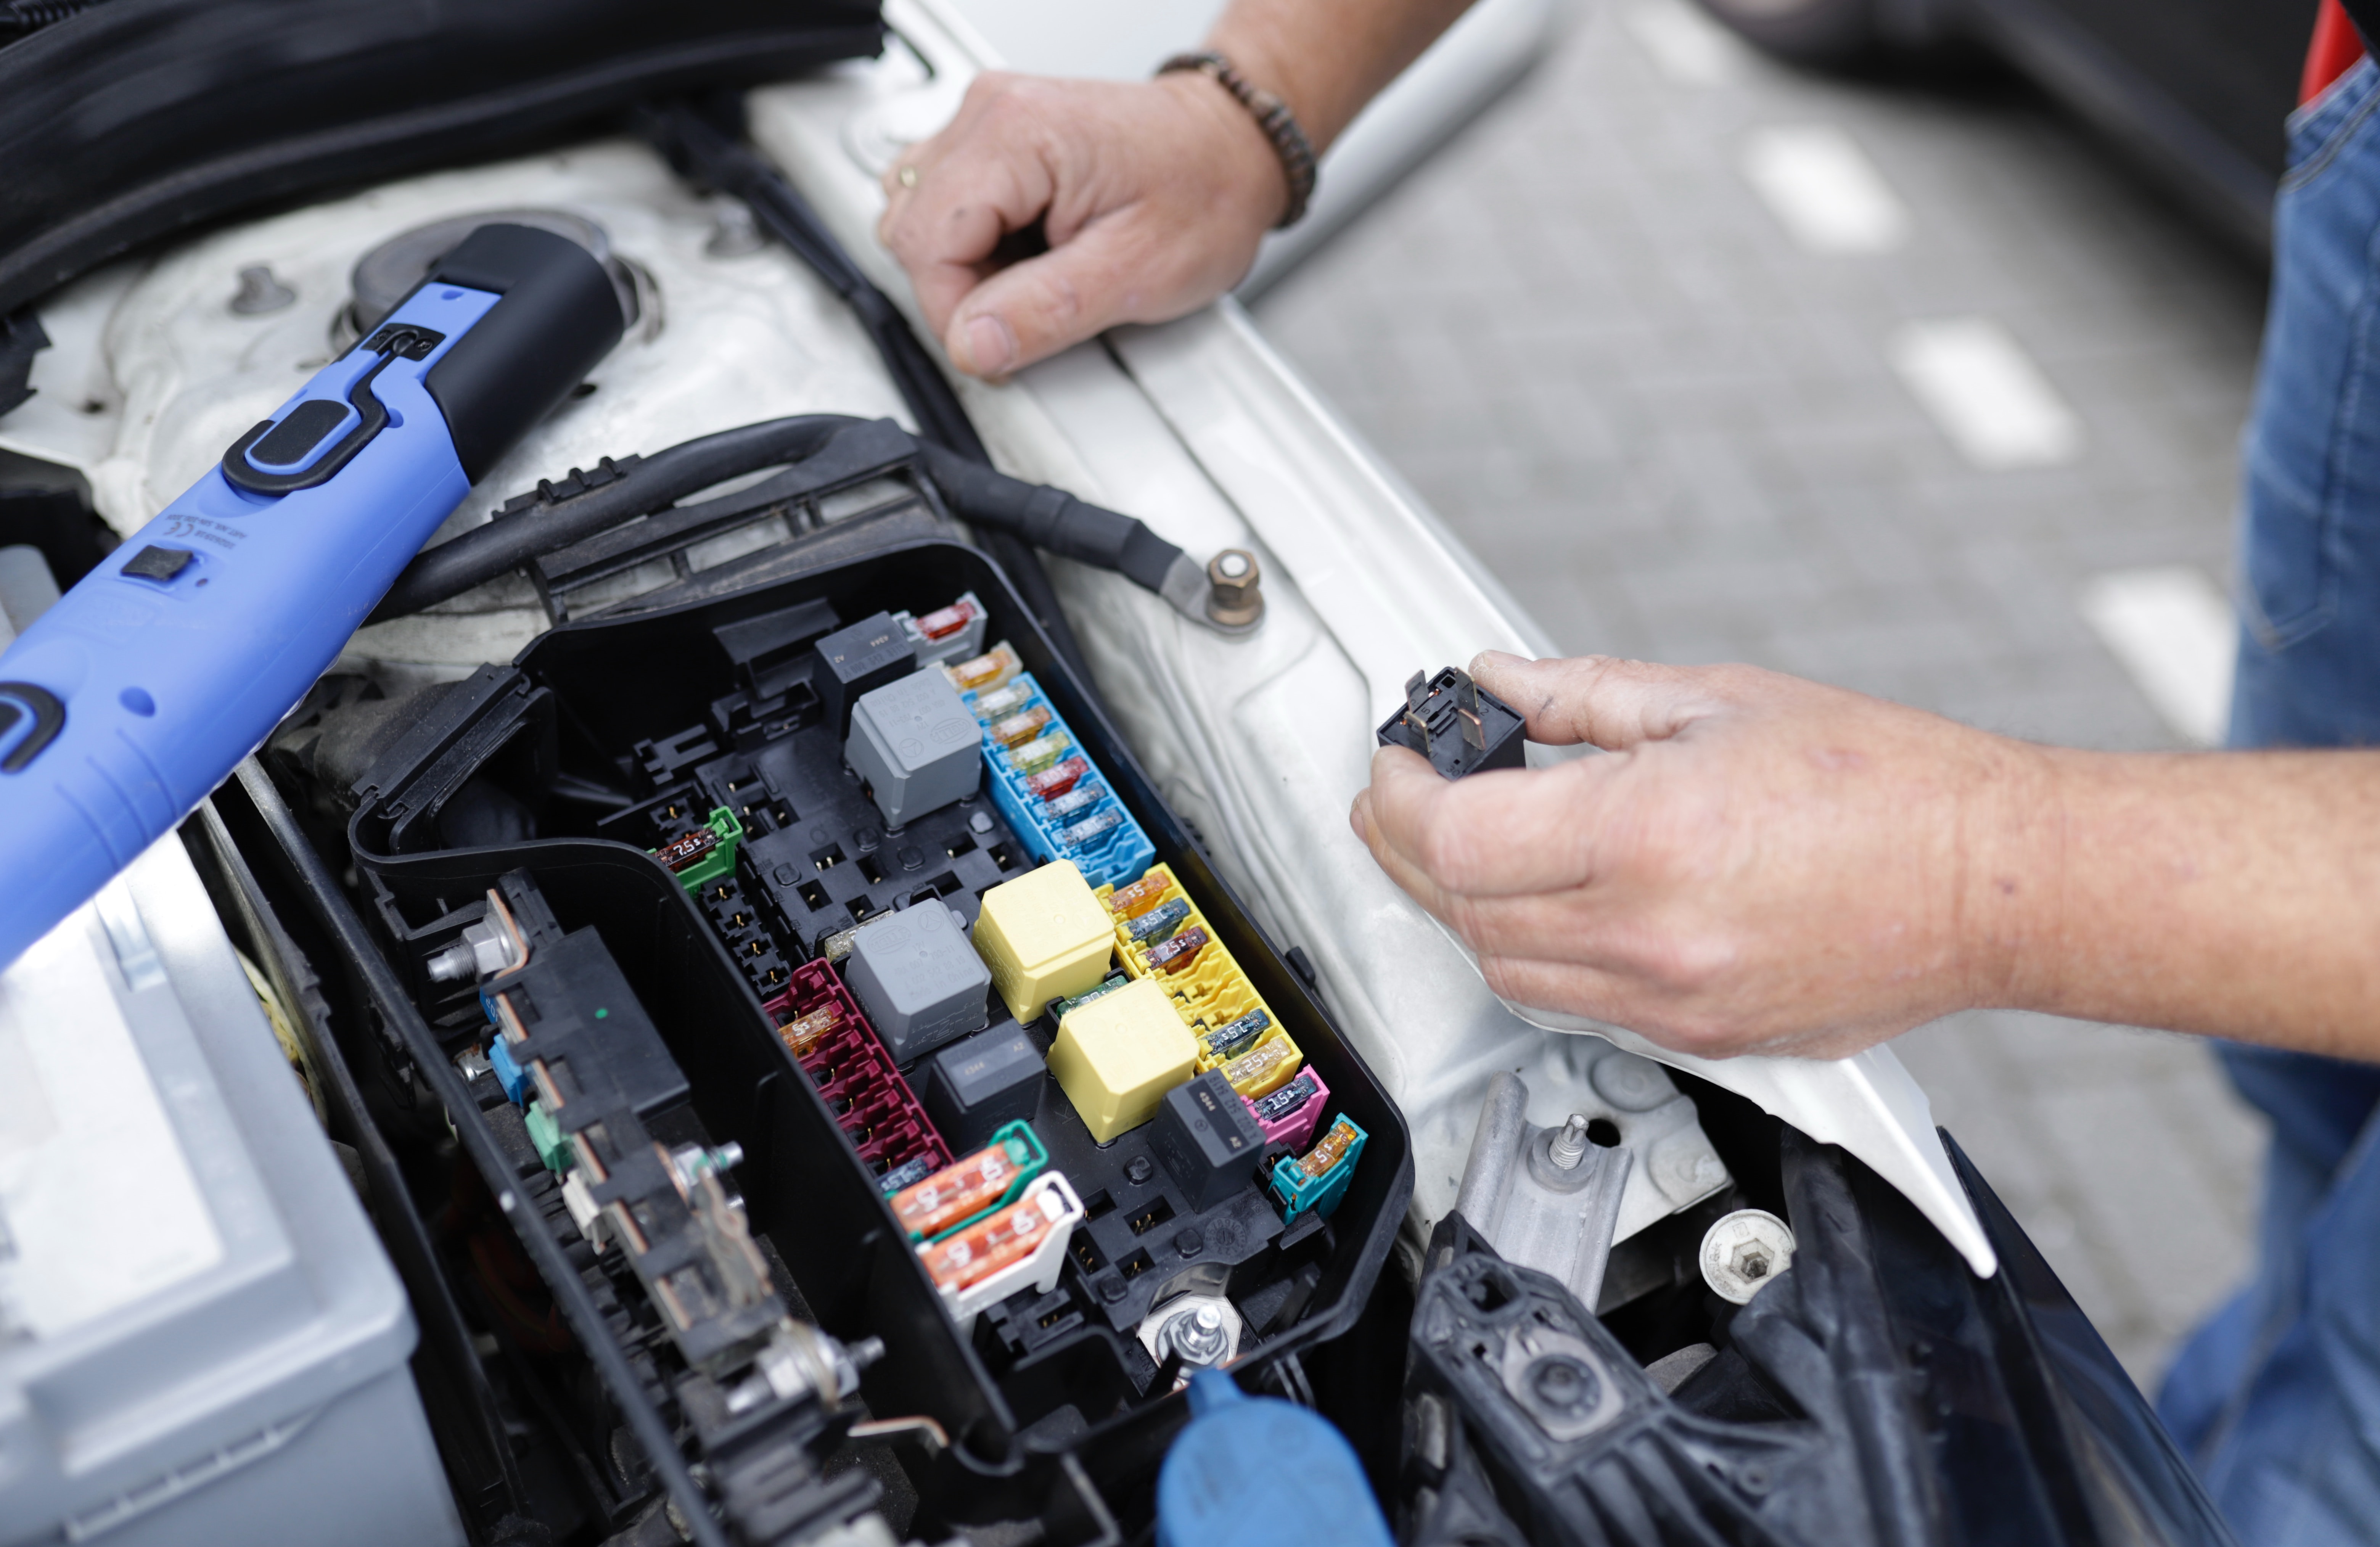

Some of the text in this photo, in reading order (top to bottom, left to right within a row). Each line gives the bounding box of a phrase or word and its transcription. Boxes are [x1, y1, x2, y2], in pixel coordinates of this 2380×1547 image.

[791, 1018, 812, 1037] 5s
[1220, 1020, 1248, 1042] 15s
[1240, 1050, 1270, 1073] 25s
[1223, 1097, 1241, 1115] 542
[1267, 1087, 1296, 1111] 15s
